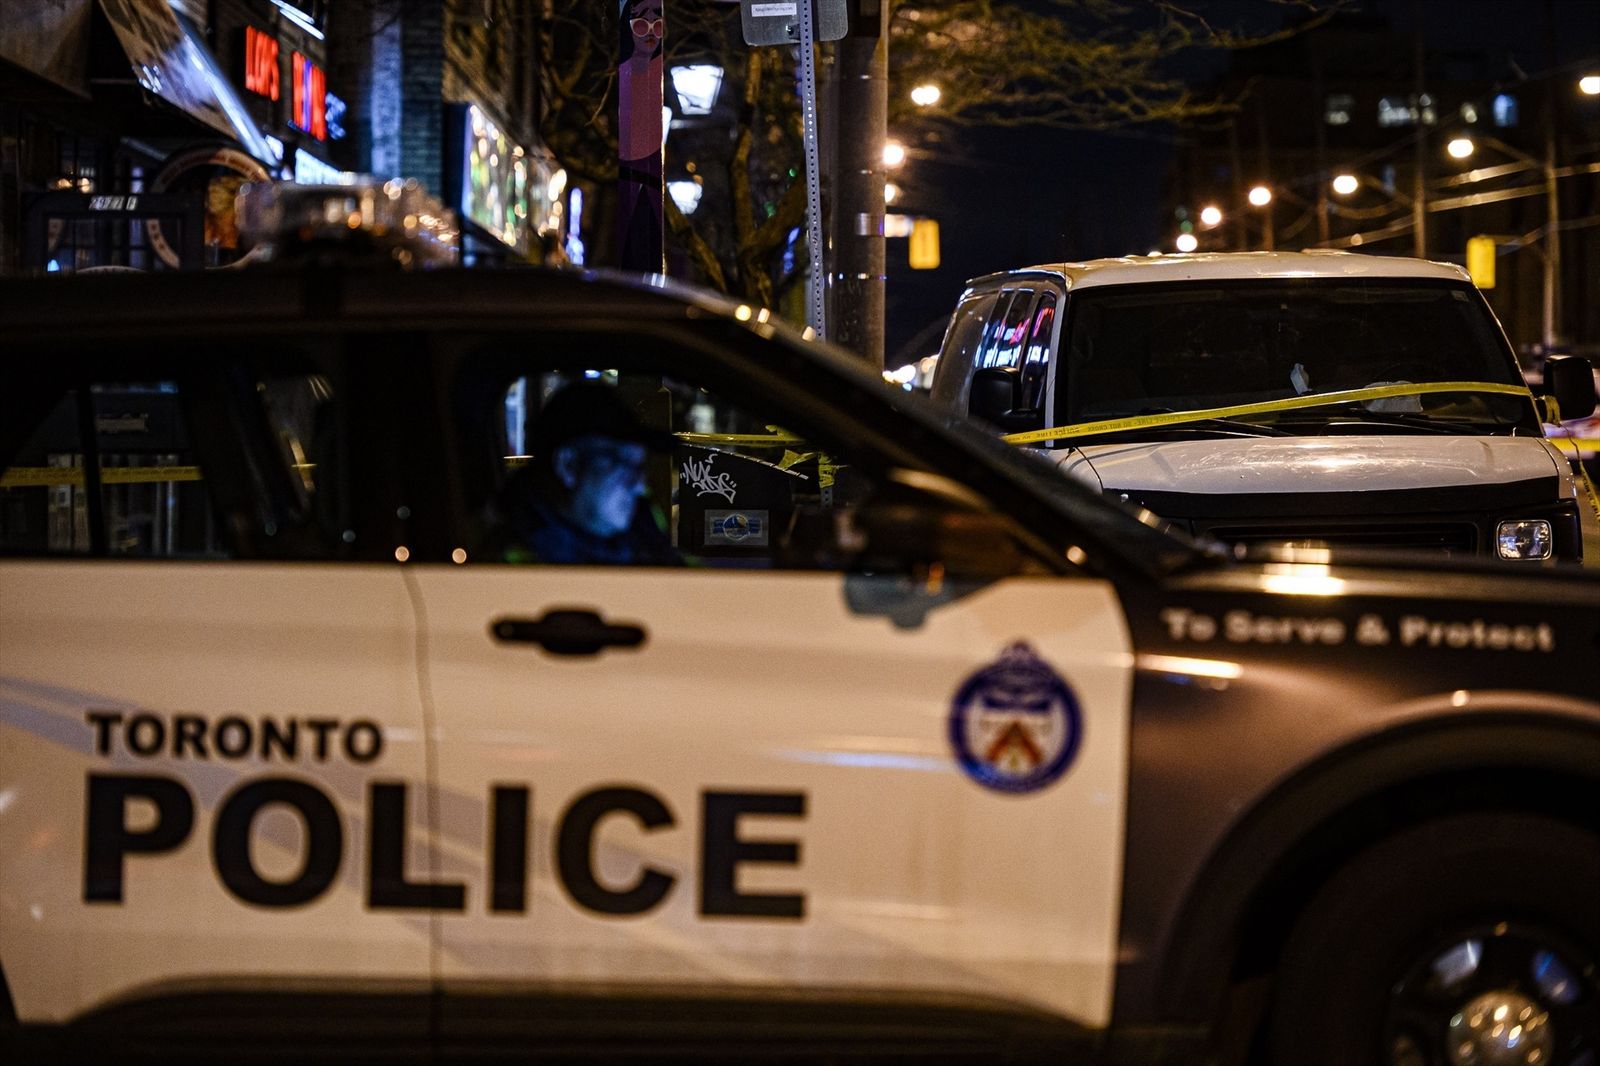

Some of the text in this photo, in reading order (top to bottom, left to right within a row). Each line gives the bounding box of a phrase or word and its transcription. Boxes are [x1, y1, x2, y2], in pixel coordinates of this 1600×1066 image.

[1162, 608, 1555, 652] To Serve & Protect
[87, 711, 384, 763] TORONTO
[82, 771, 808, 917] POLICE
